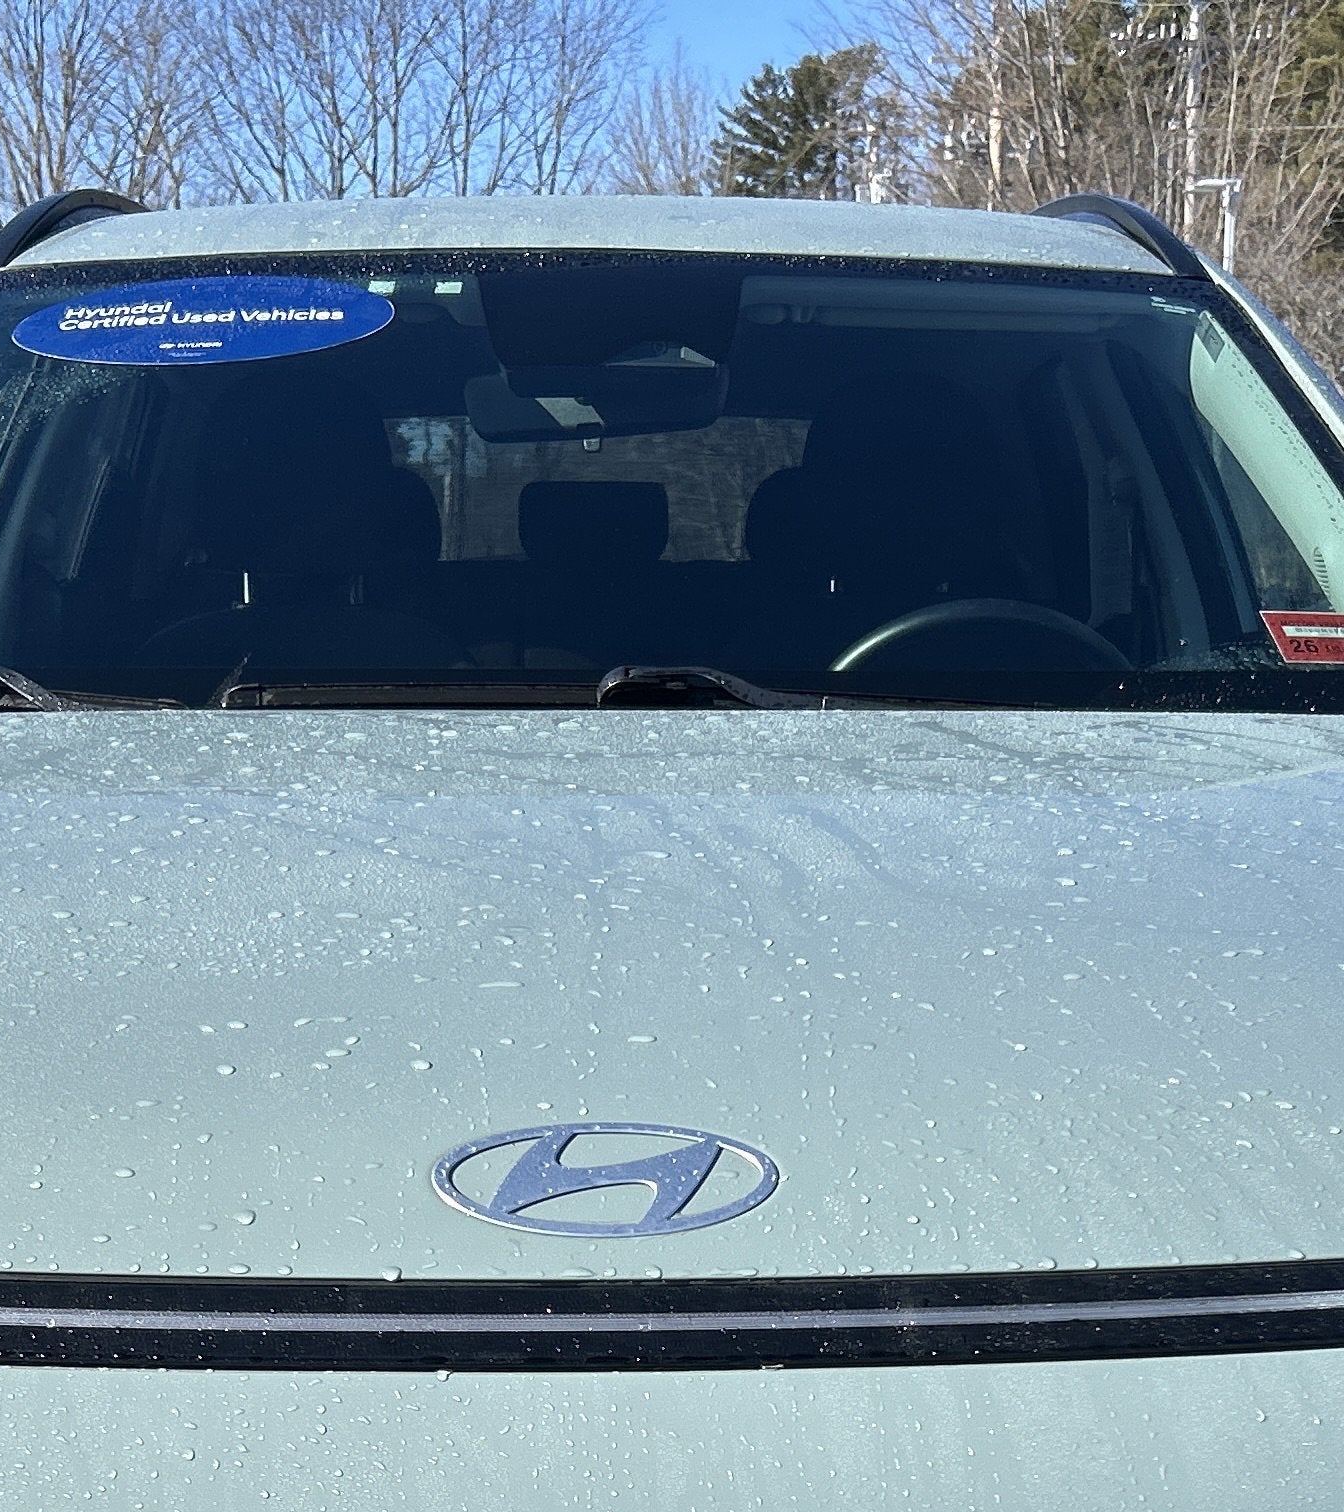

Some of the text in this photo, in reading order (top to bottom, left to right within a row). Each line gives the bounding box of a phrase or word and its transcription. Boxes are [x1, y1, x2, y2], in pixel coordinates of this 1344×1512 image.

[59, 308, 344, 331] Certified Used Vehicles
[65, 301, 173, 319] Hyundai
